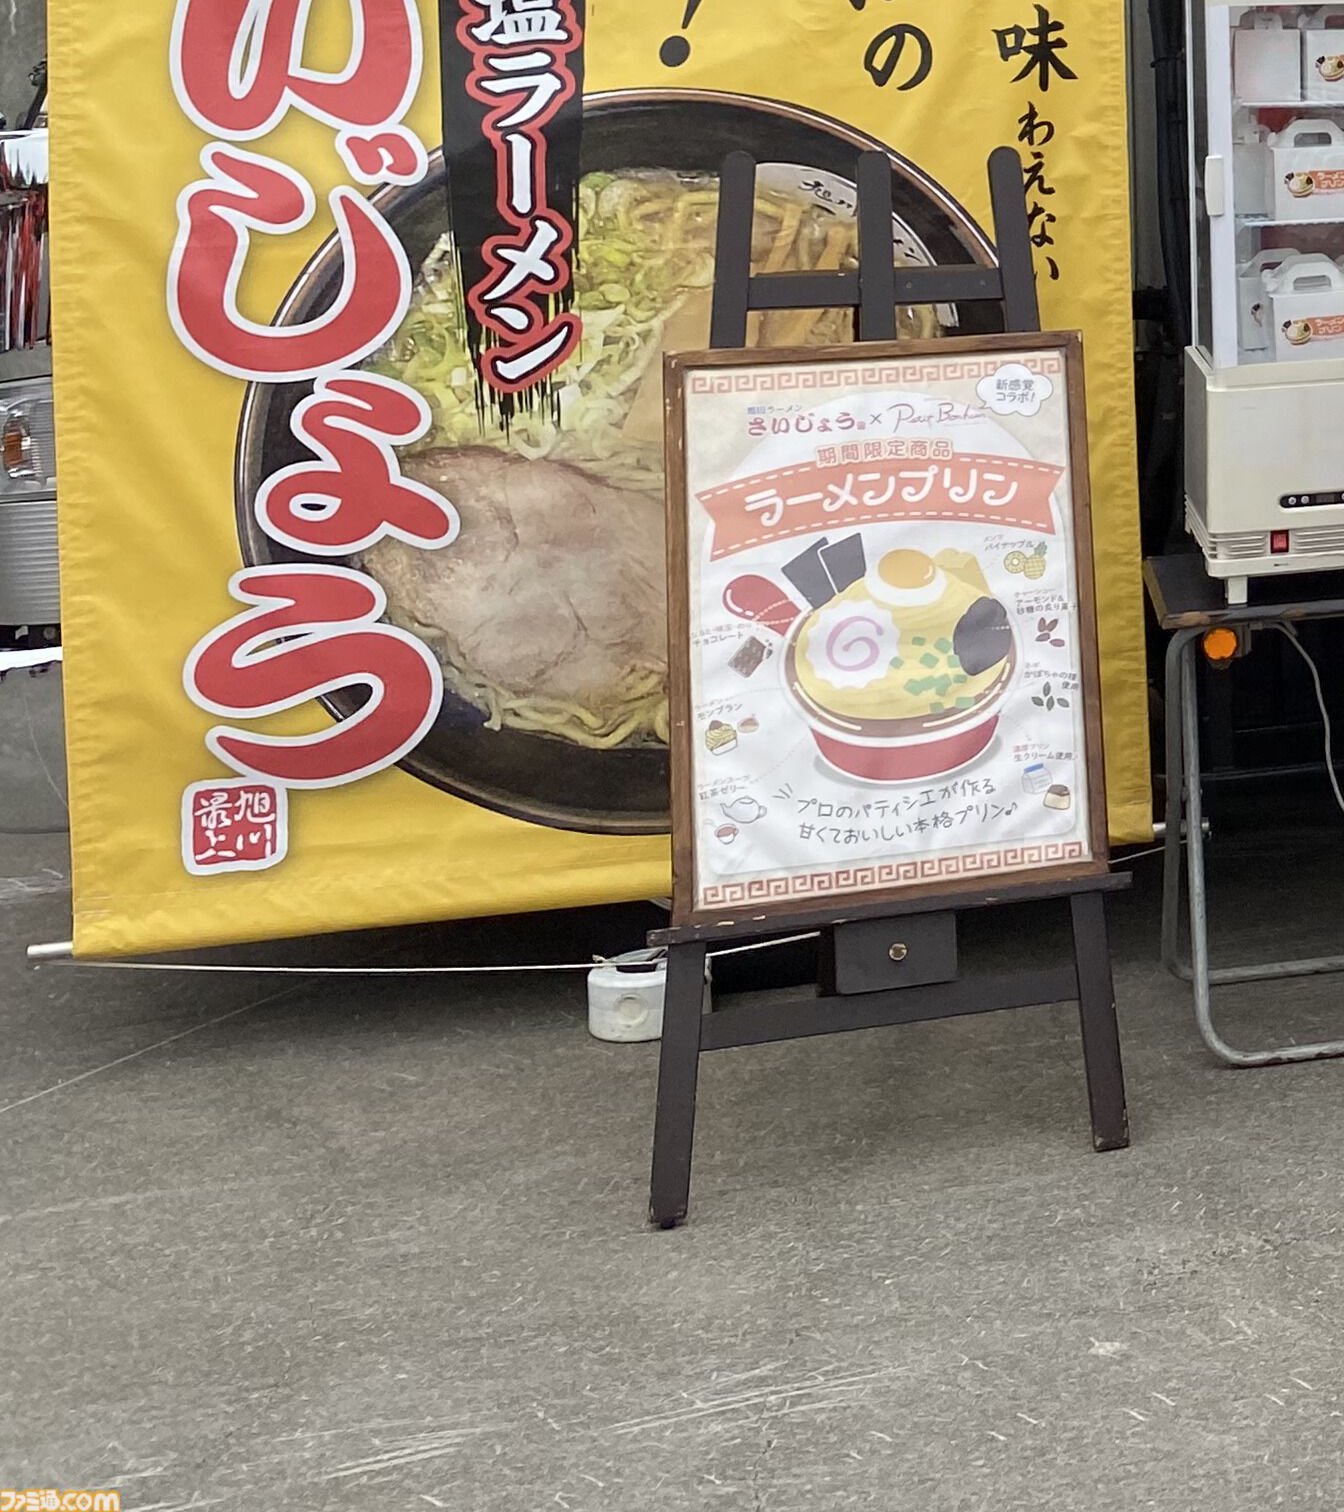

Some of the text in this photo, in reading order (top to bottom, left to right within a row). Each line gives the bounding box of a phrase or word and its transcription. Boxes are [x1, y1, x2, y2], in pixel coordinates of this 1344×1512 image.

[747, 413, 858, 437] さいじょう
[816, 440, 954, 466] 期間限定商品
[744, 465, 1018, 527] ラーメンプリン
[797, 777, 997, 819] プロのパティシエが作る
